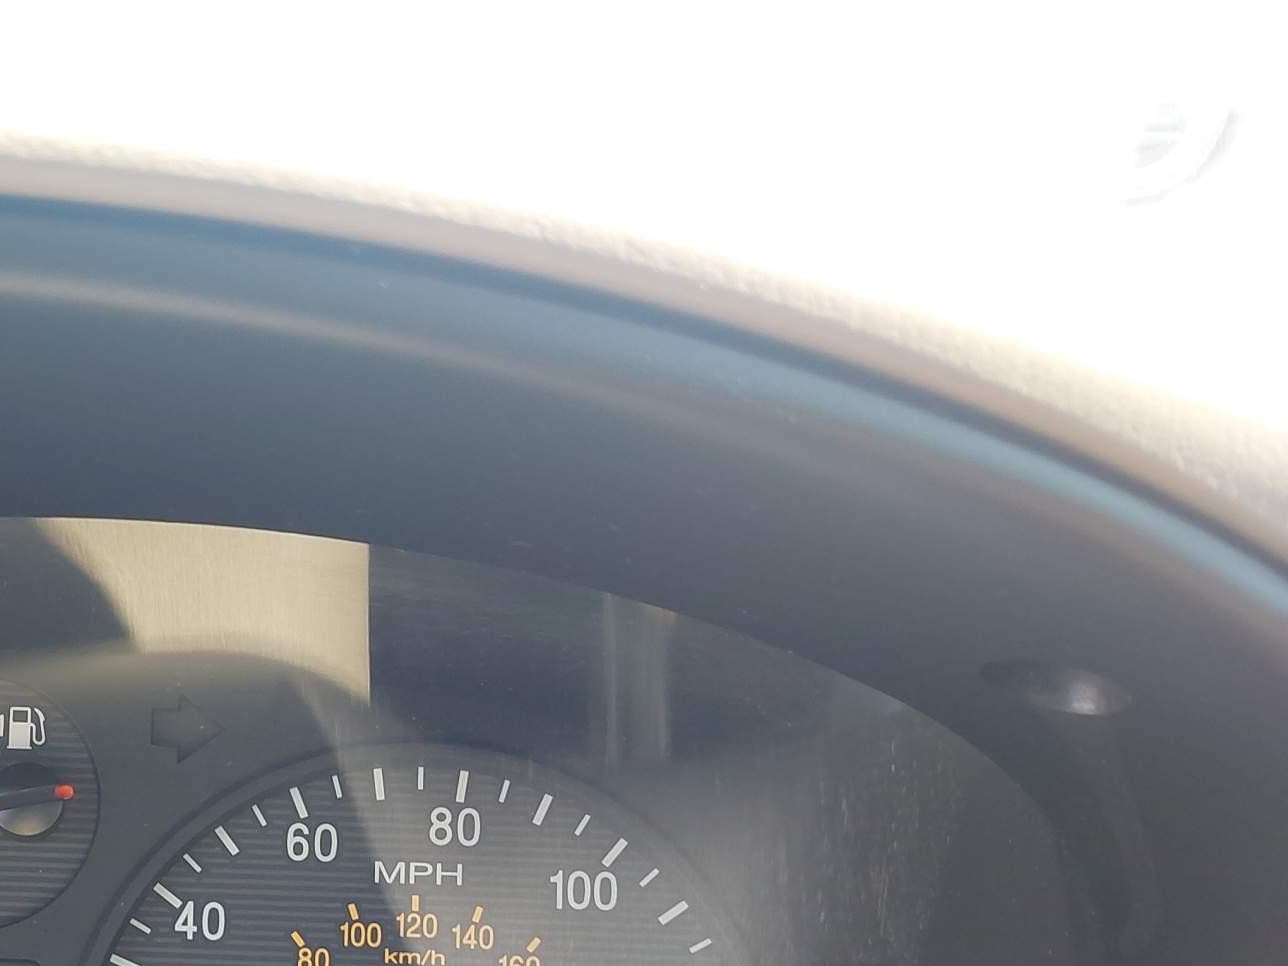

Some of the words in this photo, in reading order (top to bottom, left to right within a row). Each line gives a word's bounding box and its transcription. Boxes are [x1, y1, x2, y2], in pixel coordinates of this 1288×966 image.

[429, 807, 481, 848] 80
[286, 823, 338, 863] 60
[374, 861, 463, 886] MPH
[550, 869, 617, 912] 100
[174, 901, 225, 942] 40
[340, 921, 382, 948] 100
[395, 913, 438, 939] 120
[452, 924, 494, 950] 140
[384, 947, 446, 966] km/h
